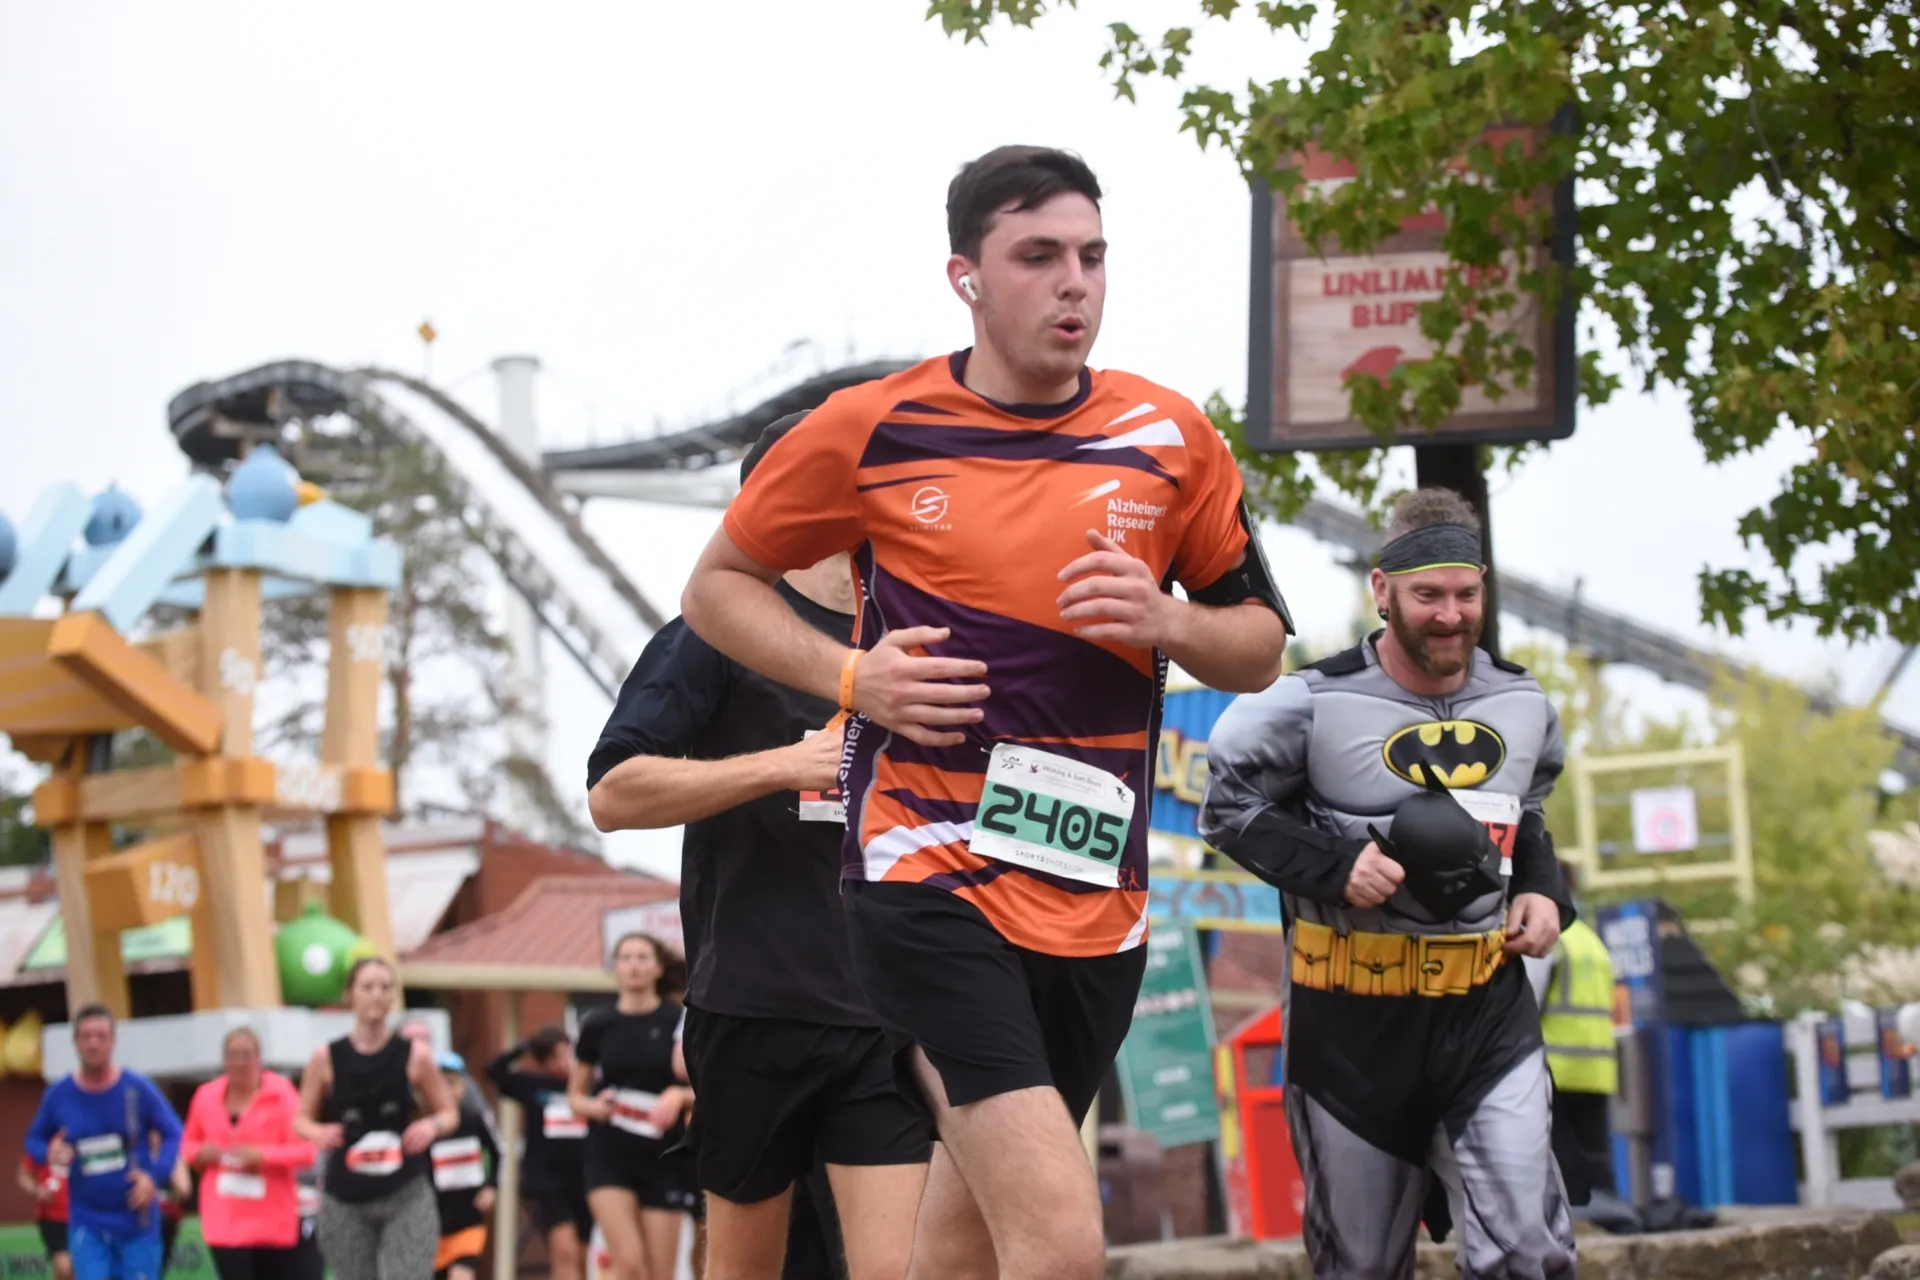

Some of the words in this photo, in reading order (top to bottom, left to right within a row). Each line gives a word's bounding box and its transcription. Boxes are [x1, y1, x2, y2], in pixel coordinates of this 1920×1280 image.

[1322, 266, 1508, 296] UNLIMIED
[1107, 529, 1126, 543] UK
[981, 784, 1124, 861] 2405
